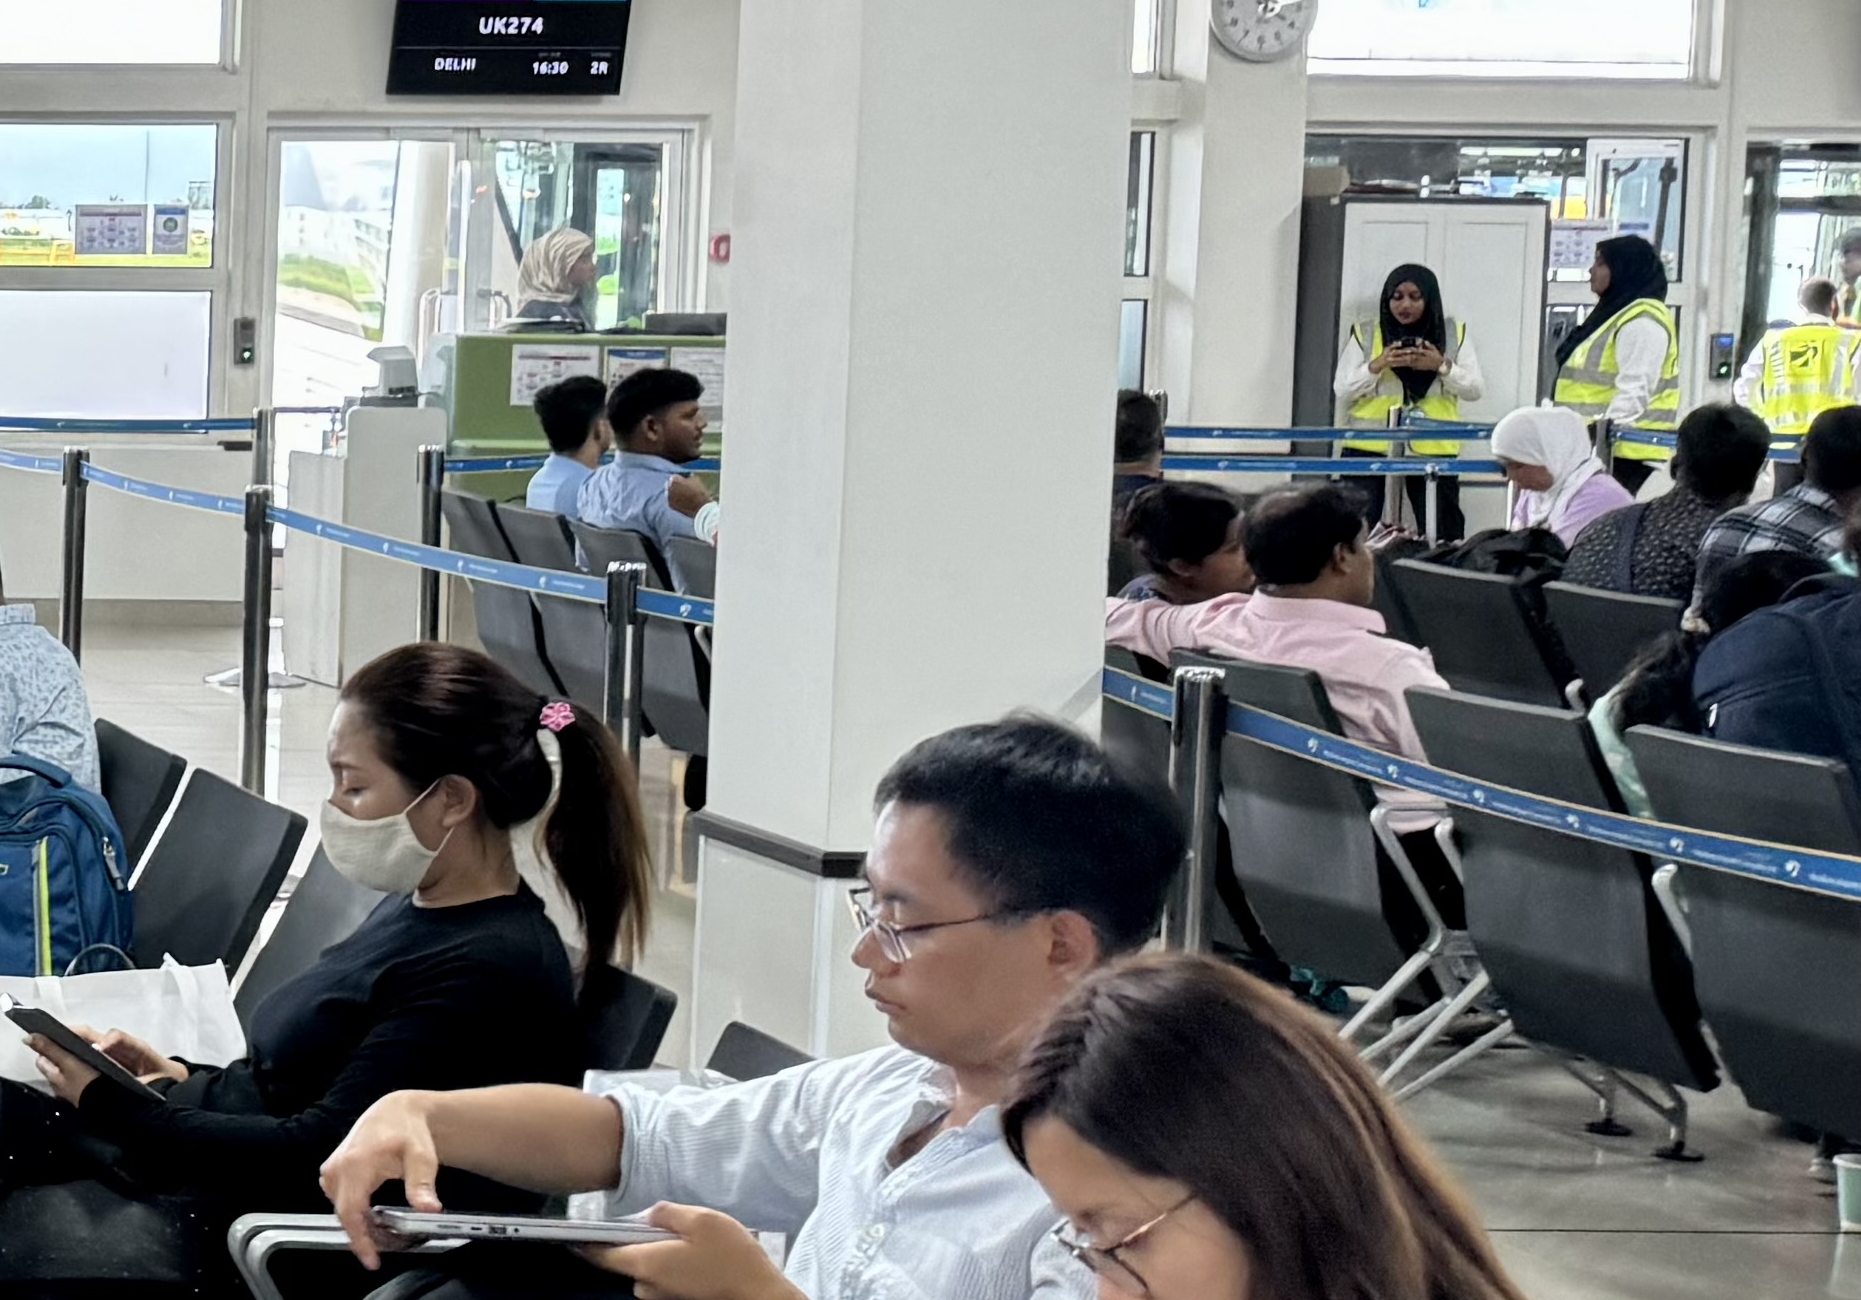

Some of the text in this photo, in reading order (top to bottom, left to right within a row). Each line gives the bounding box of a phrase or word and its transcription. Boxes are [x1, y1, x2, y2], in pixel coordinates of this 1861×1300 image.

[479, 17, 544, 35] UK274
[434, 57, 609, 75] DELHI 16:30 2R
